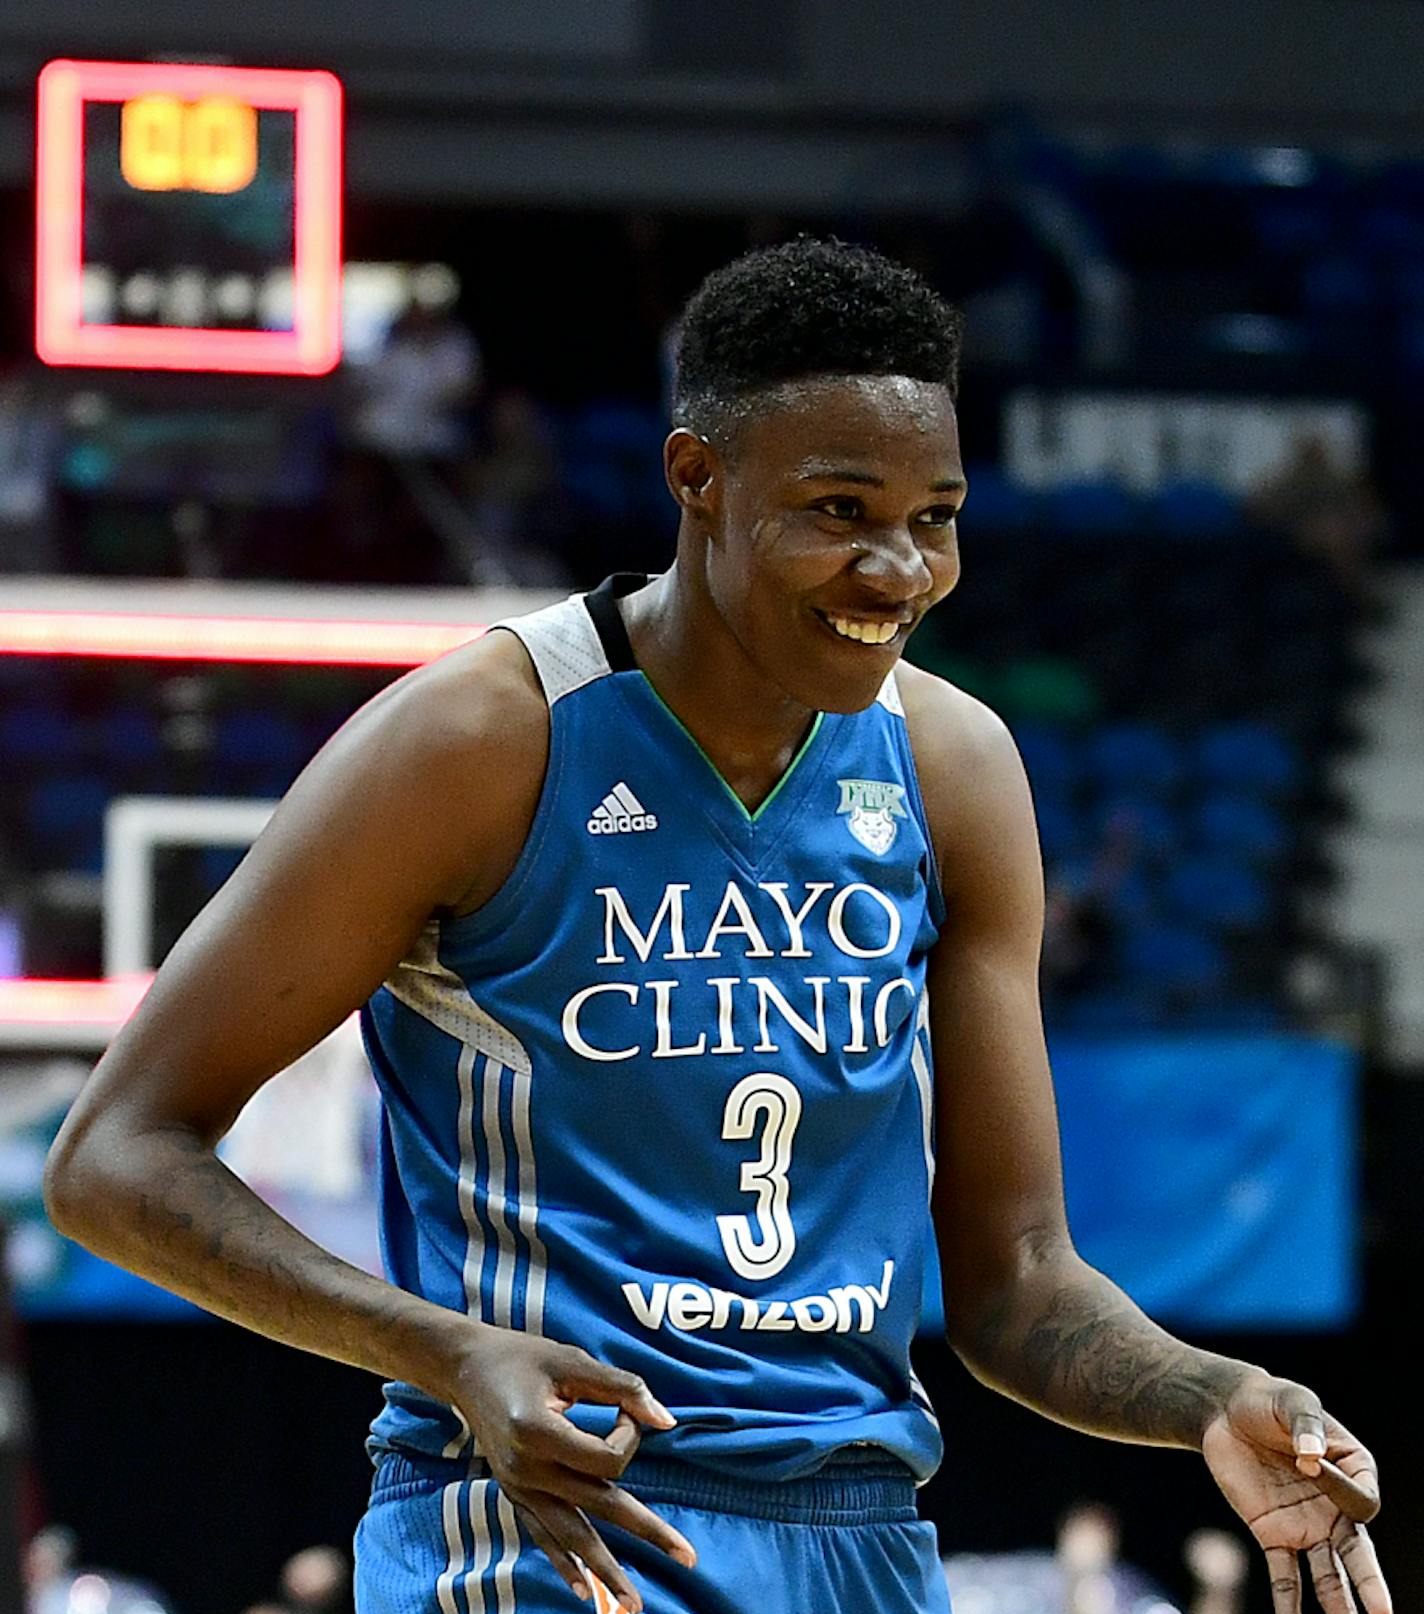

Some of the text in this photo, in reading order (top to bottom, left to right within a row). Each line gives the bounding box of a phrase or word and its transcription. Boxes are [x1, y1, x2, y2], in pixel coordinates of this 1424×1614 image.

[586, 814, 658, 835] adidas
[594, 880, 901, 964] MAYO
[715, 1072, 802, 1281] 3
